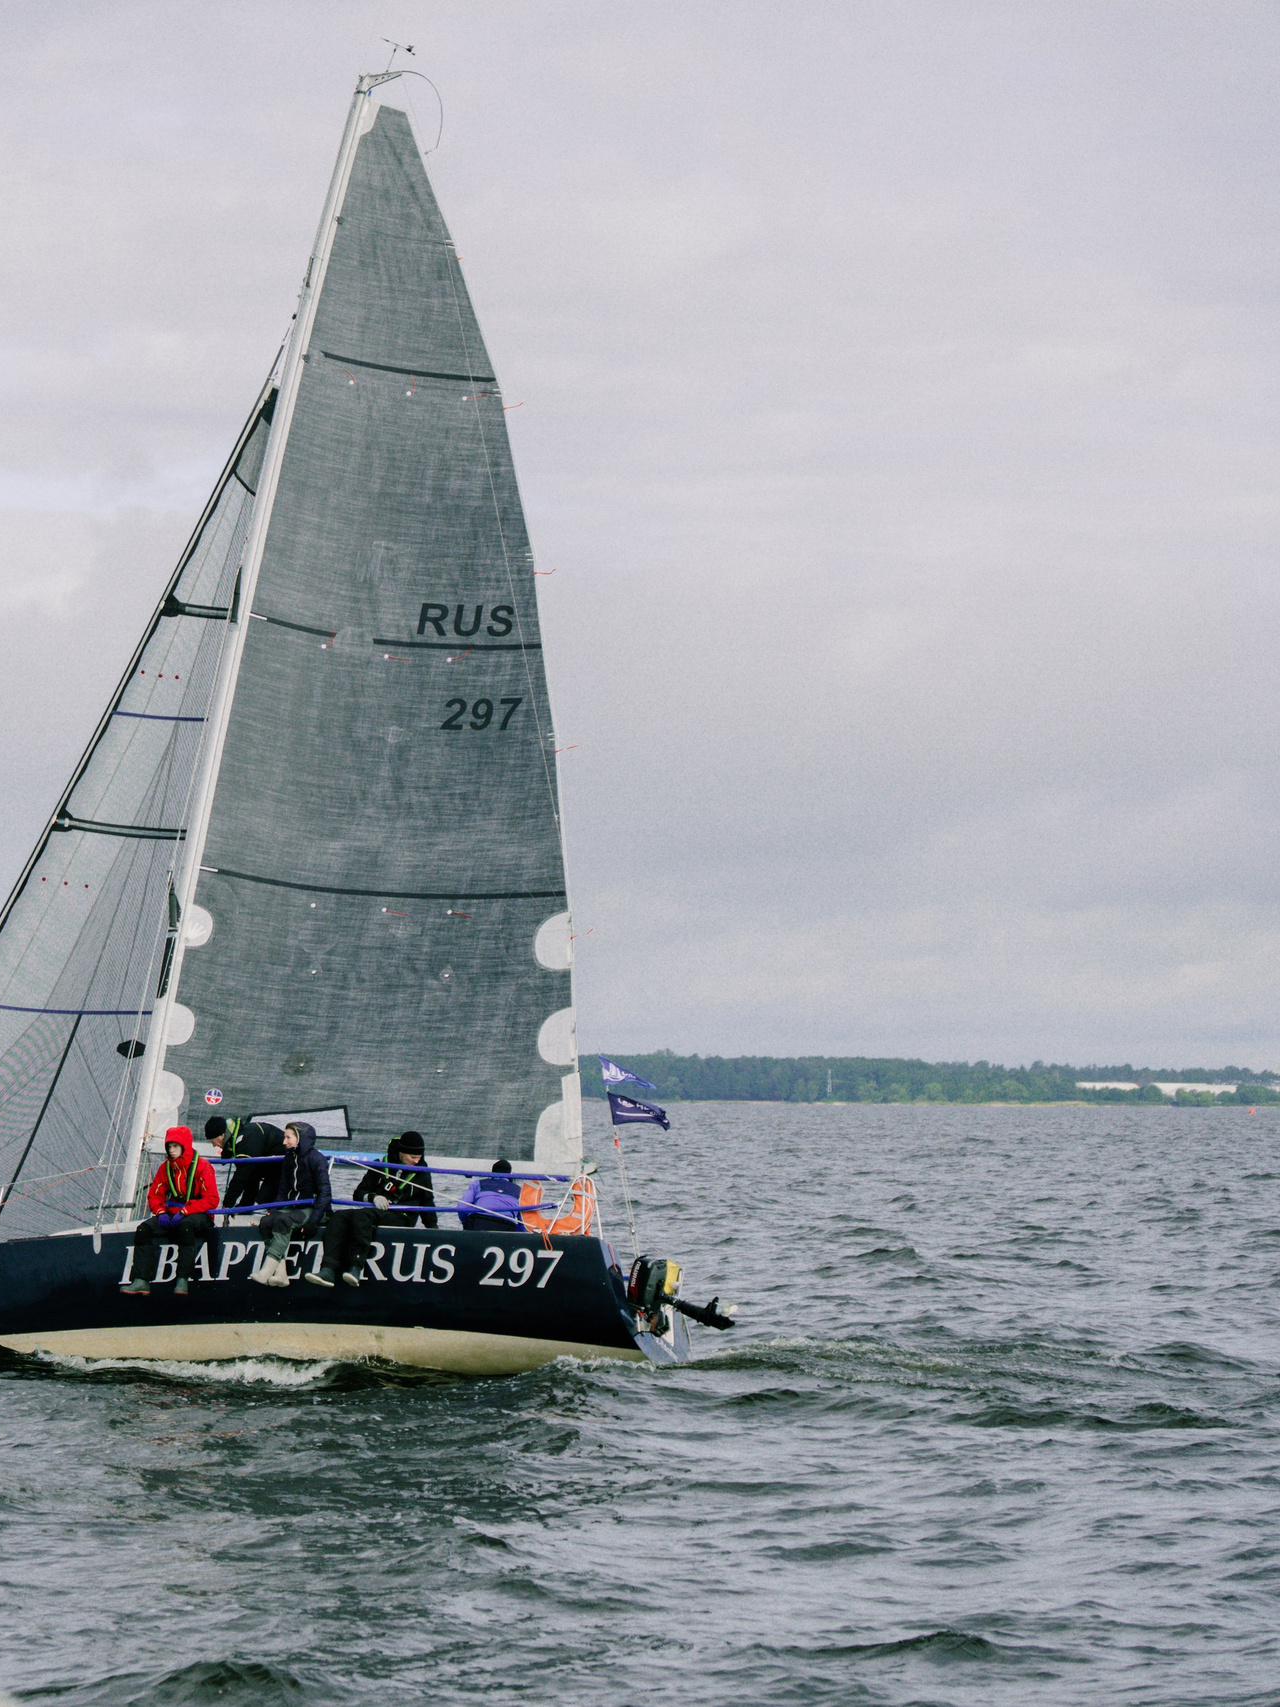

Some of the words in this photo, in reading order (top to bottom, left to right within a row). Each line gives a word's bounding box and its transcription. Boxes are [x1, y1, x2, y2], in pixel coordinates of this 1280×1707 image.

[417, 603, 514, 636] RUS
[440, 698, 523, 730] 297
[359, 1242, 456, 1284] RUS
[479, 1246, 563, 1288] 297
